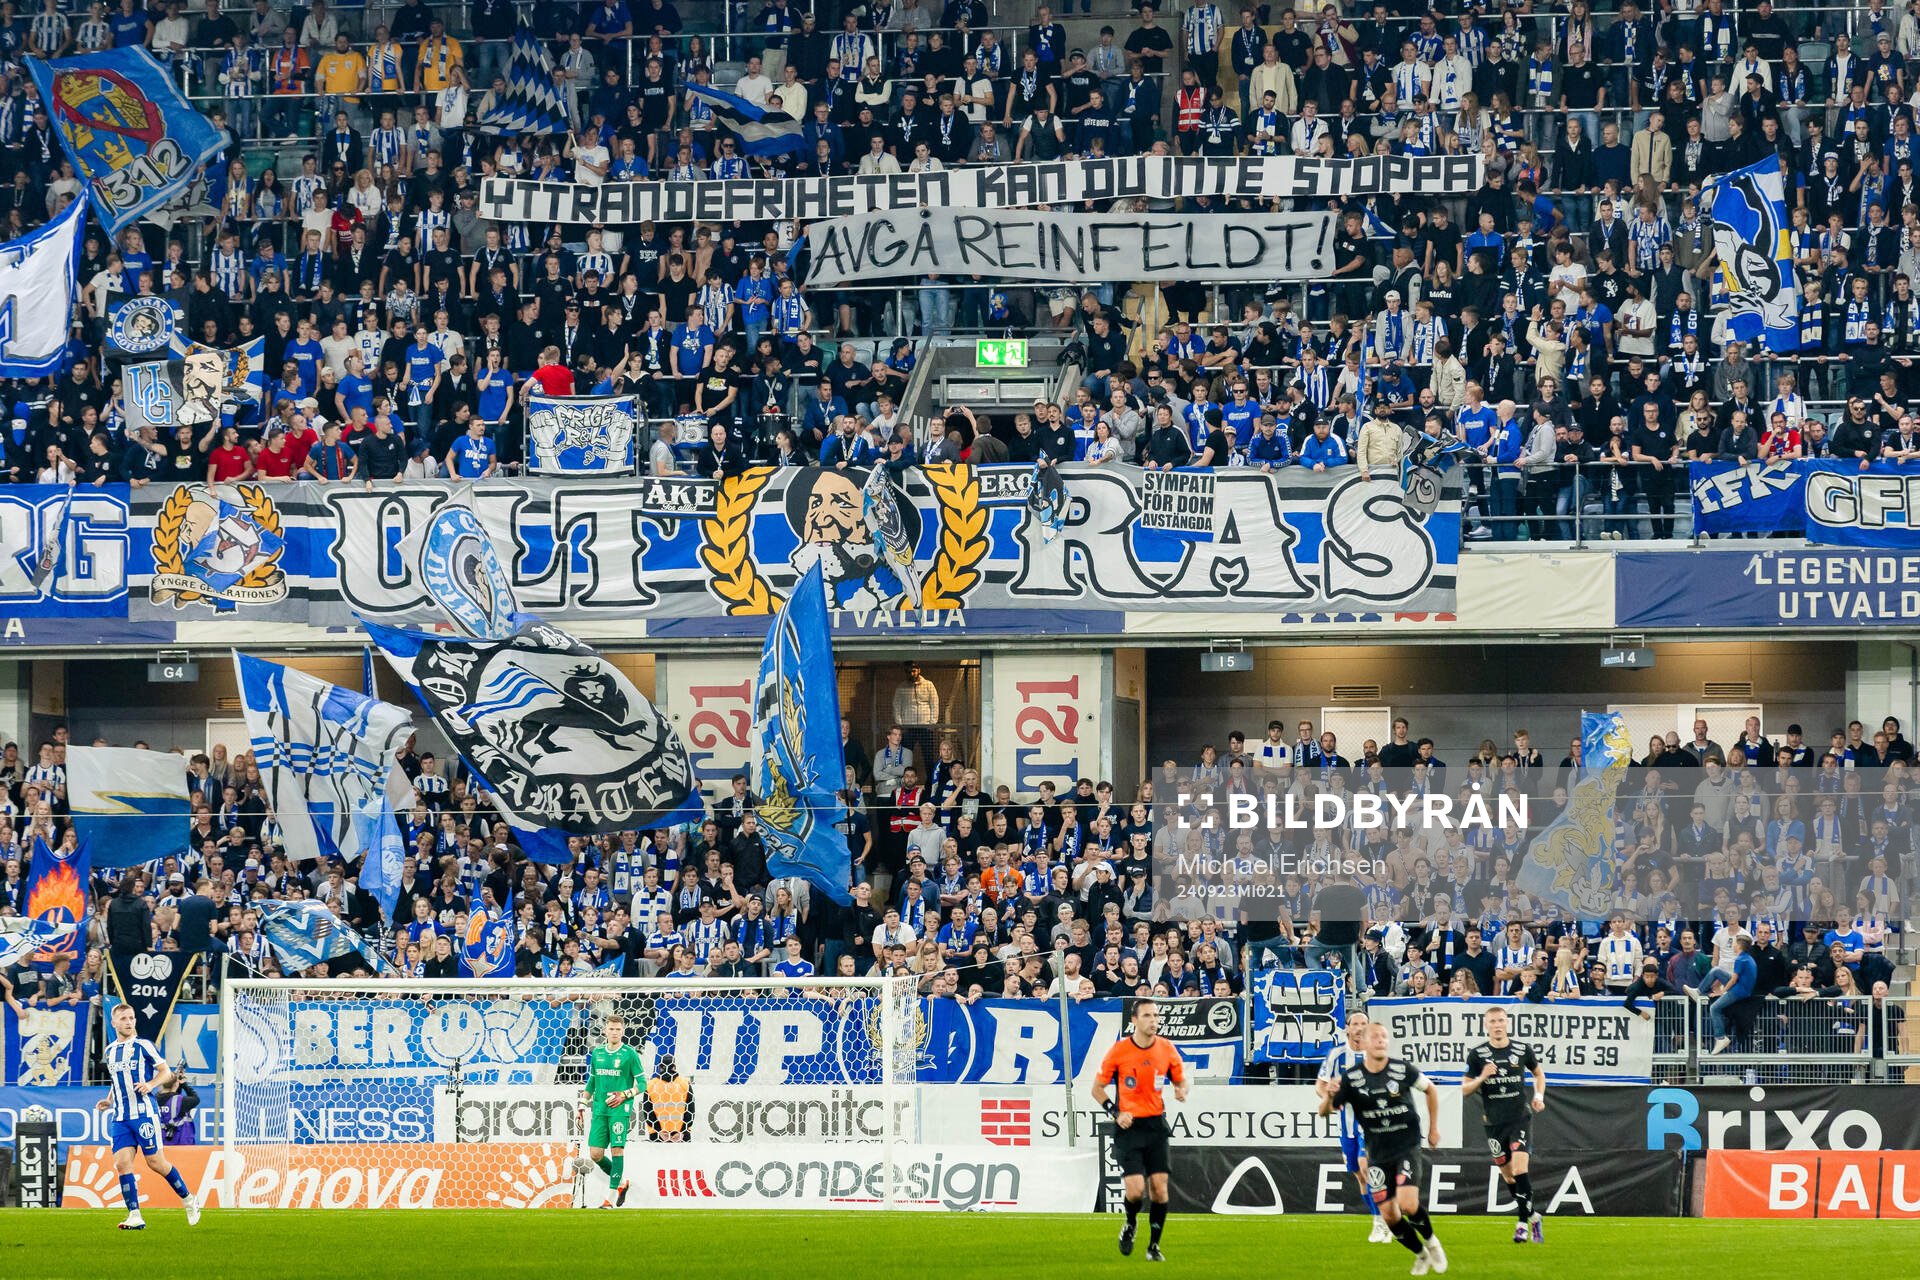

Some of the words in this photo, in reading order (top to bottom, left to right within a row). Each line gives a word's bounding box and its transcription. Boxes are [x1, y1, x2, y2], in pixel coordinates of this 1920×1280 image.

[484, 171, 950, 223] YTTRANDEFRIHETEN
[977, 162, 1067, 208] KAN
[1081, 156, 1146, 200] DU
[1161, 156, 1265, 197] INTE
[1292, 154, 1478, 196] STOPPA
[811, 209, 940, 280] AVGÅ
[954, 214, 1330, 275] REINFELDT!
[128, 362, 173, 425] UG
[646, 479, 715, 505] ÅKE
[1144, 473, 1215, 493] SYMPATI
[1144, 490, 1174, 512] FÖR
[1177, 495, 1214, 514] DOM
[1806, 471, 1920, 530] GF
[1142, 513, 1213, 531] AVSTÄNGDA
[160, 576, 196, 590] YNGRE
[200, 583, 279, 599] GERATIONEN
[163, 666, 184, 679] G4
[131, 984, 168, 999] 2014
[1124, 1023, 1207, 1036] ATÄNGDA
[1168, 1015, 1186, 1025] DE
[1391, 1007, 1451, 1039] STÖD
[1462, 1013, 1631, 1041] TIOGRUPPEN
[1565, 1046, 1586, 1065] 15
[1594, 1046, 1619, 1067] 39
[596, 1068, 622, 1077] SERNEKE
[1647, 1087, 1883, 1150] Brixo
[197, 1150, 444, 1209] Renova
